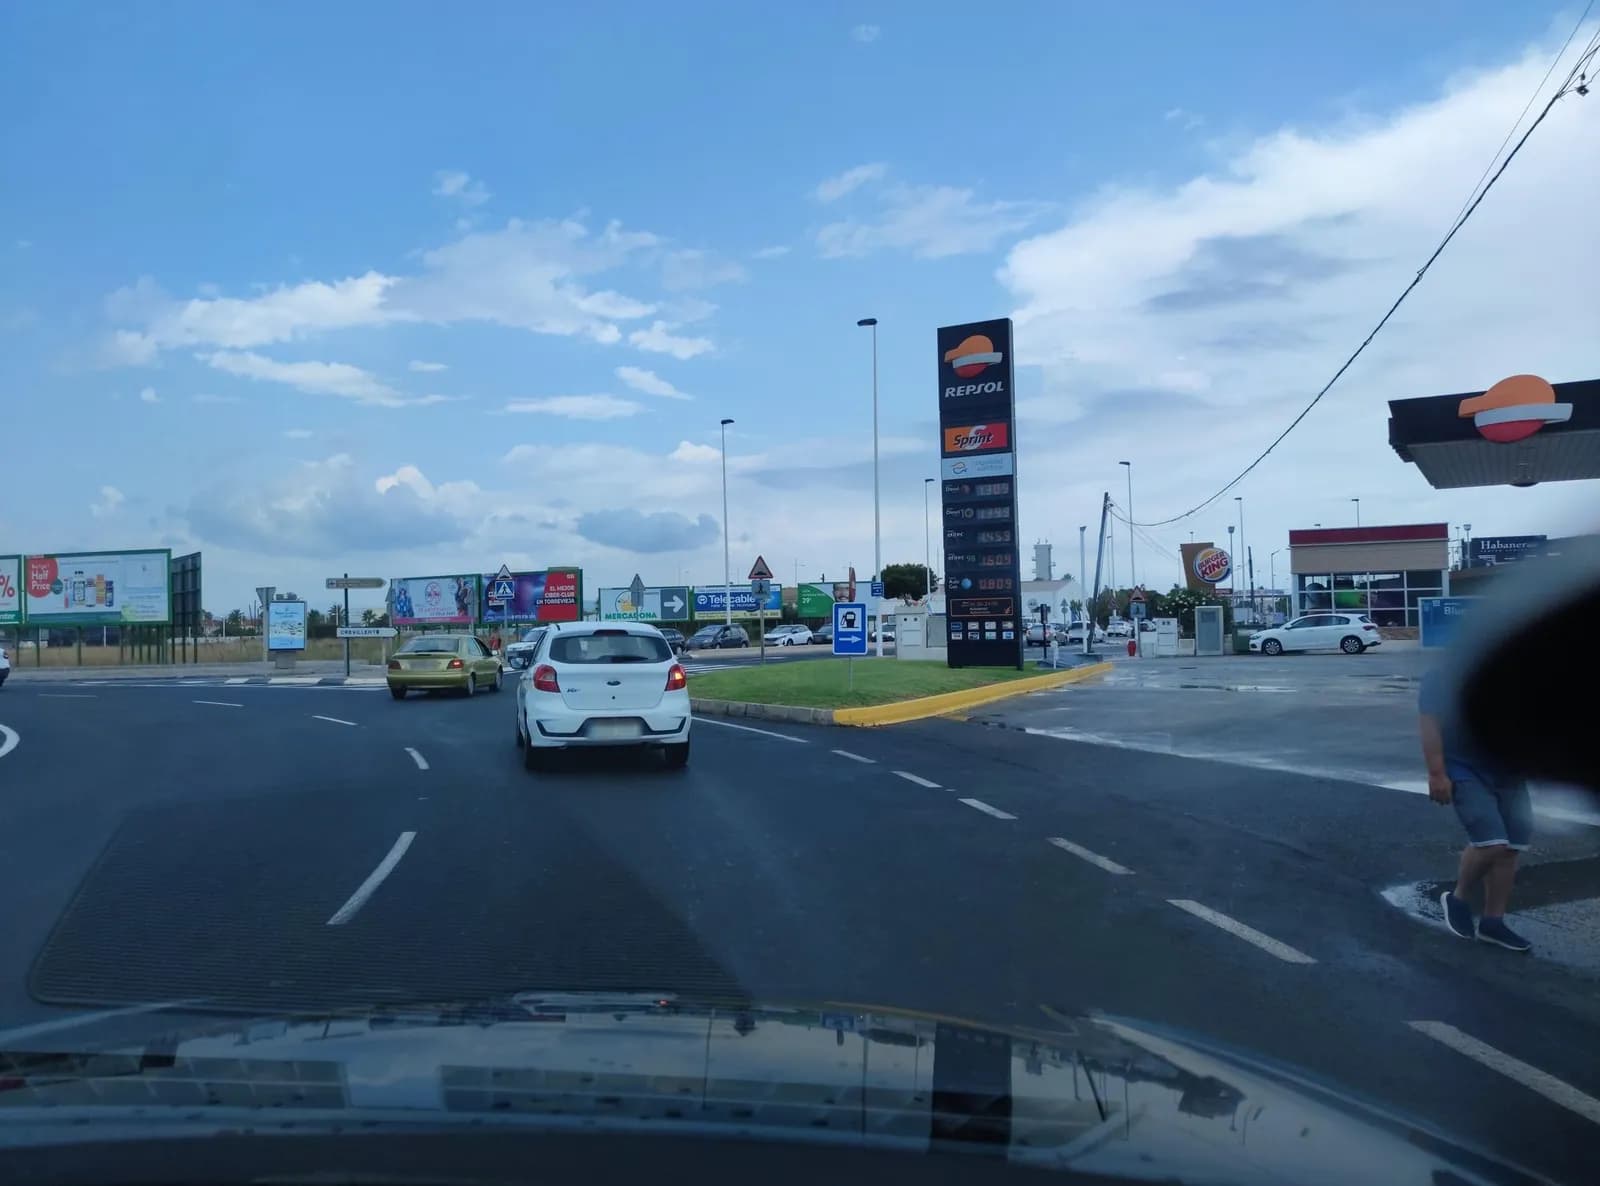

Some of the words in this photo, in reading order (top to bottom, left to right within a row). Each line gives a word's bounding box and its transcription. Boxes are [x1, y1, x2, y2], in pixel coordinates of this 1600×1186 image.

[945, 381, 1004, 398] REPSOL
[953, 433, 993, 448] Sprint
[1198, 550, 1226, 570] BURGER
[1201, 557, 1228, 578] KING
[31, 569, 48, 579] Half
[31, 581, 51, 591] Price
